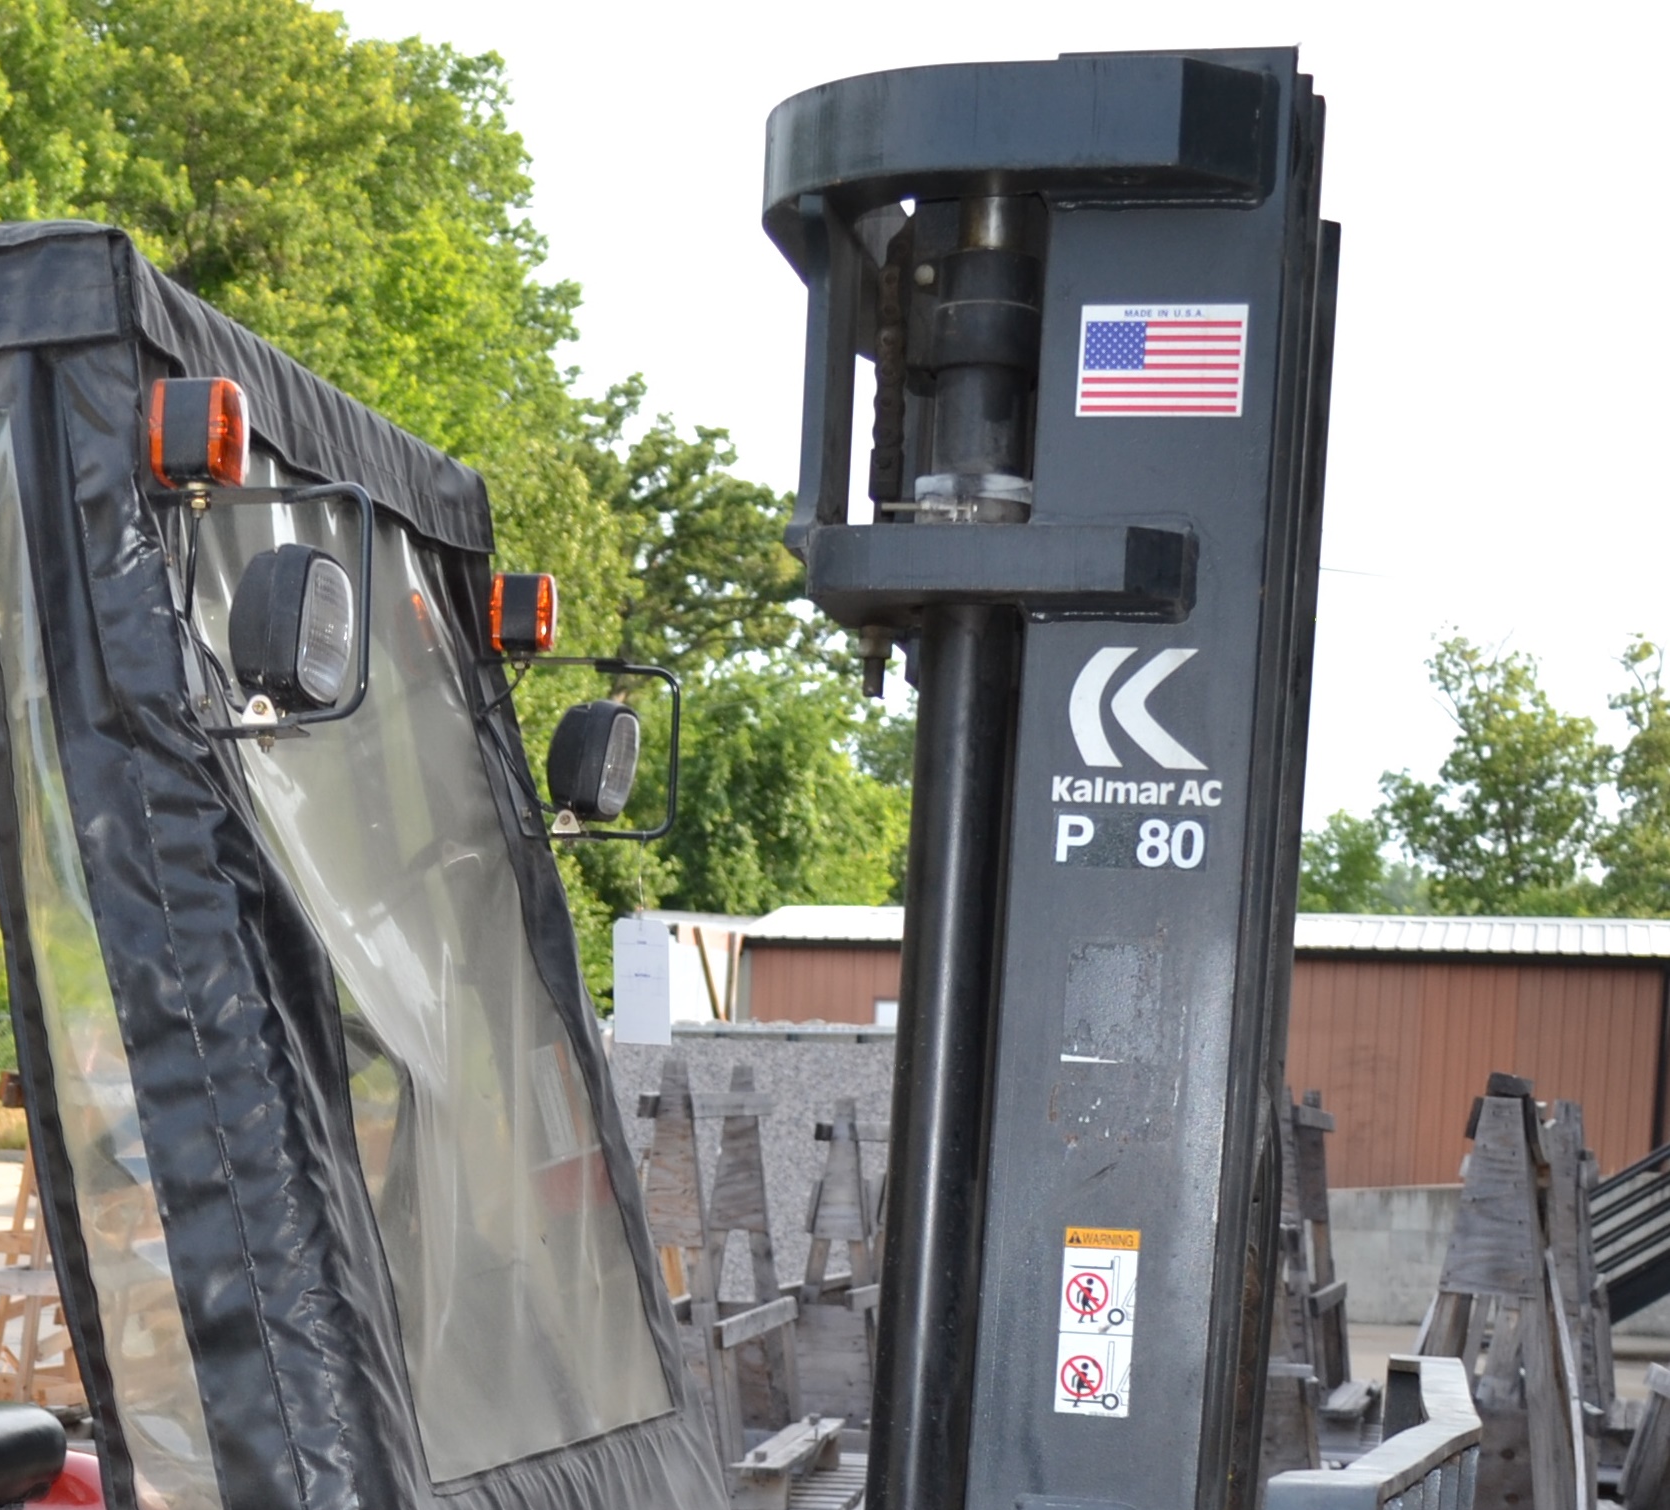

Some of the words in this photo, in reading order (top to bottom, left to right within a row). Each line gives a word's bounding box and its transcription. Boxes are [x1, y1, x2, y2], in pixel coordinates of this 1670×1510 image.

[1124, 309, 1153, 318] MADE
[1157, 309, 1169, 318] IN
[1173, 309, 1205, 318] U.S.A.
[1051, 775, 1175, 806] Kalmar
[1177, 779, 1223, 807] AC
[1055, 814, 1094, 863] P
[1136, 818, 1205, 870] 80
[1082, 1231, 1135, 1247] WARNING
